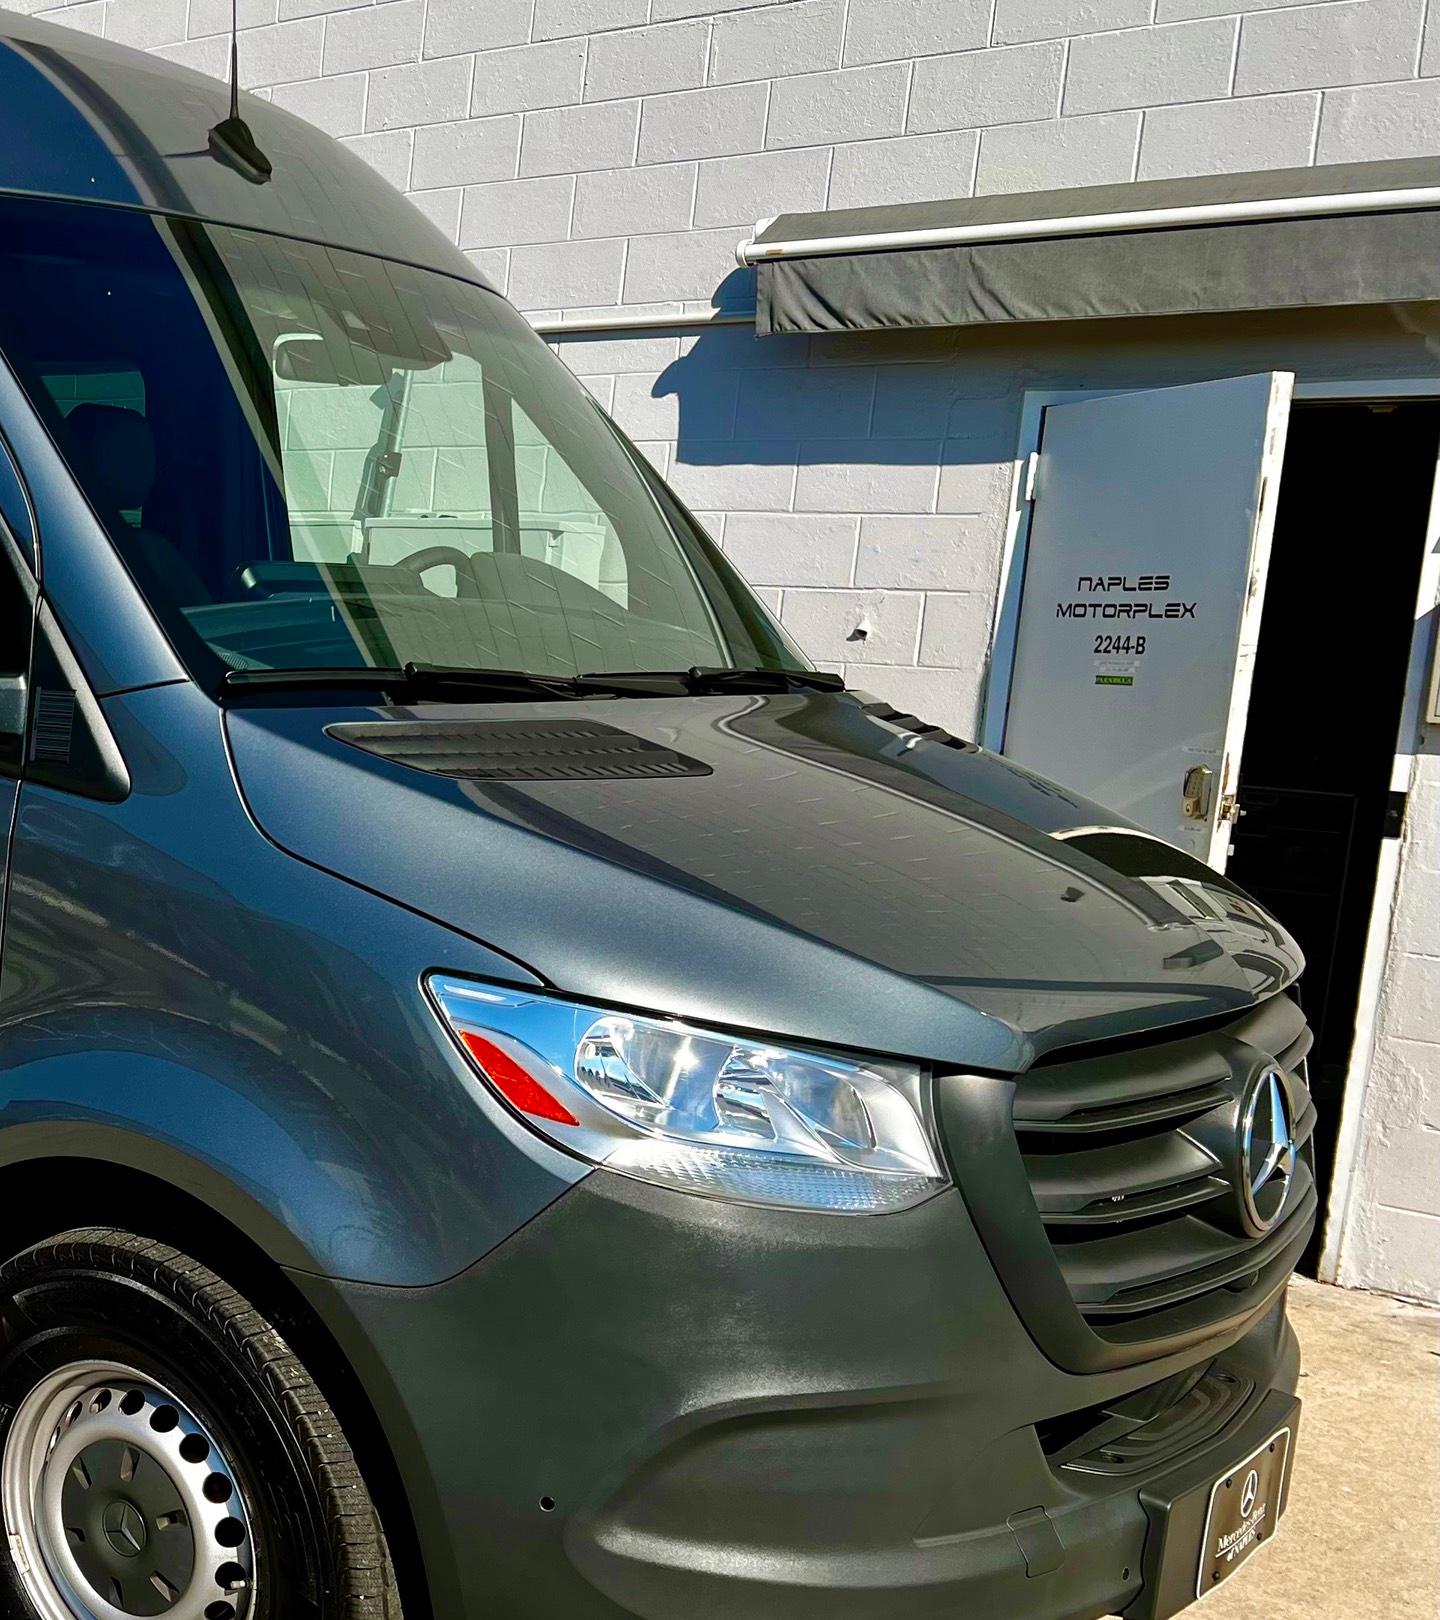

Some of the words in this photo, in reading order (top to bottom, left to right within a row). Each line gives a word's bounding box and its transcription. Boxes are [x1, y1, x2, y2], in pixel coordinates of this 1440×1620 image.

[1077, 576, 1170, 592] NAPLES
[1056, 602, 1197, 619] MOTORPLEX
[1093, 635, 1146, 655] 2244-B
